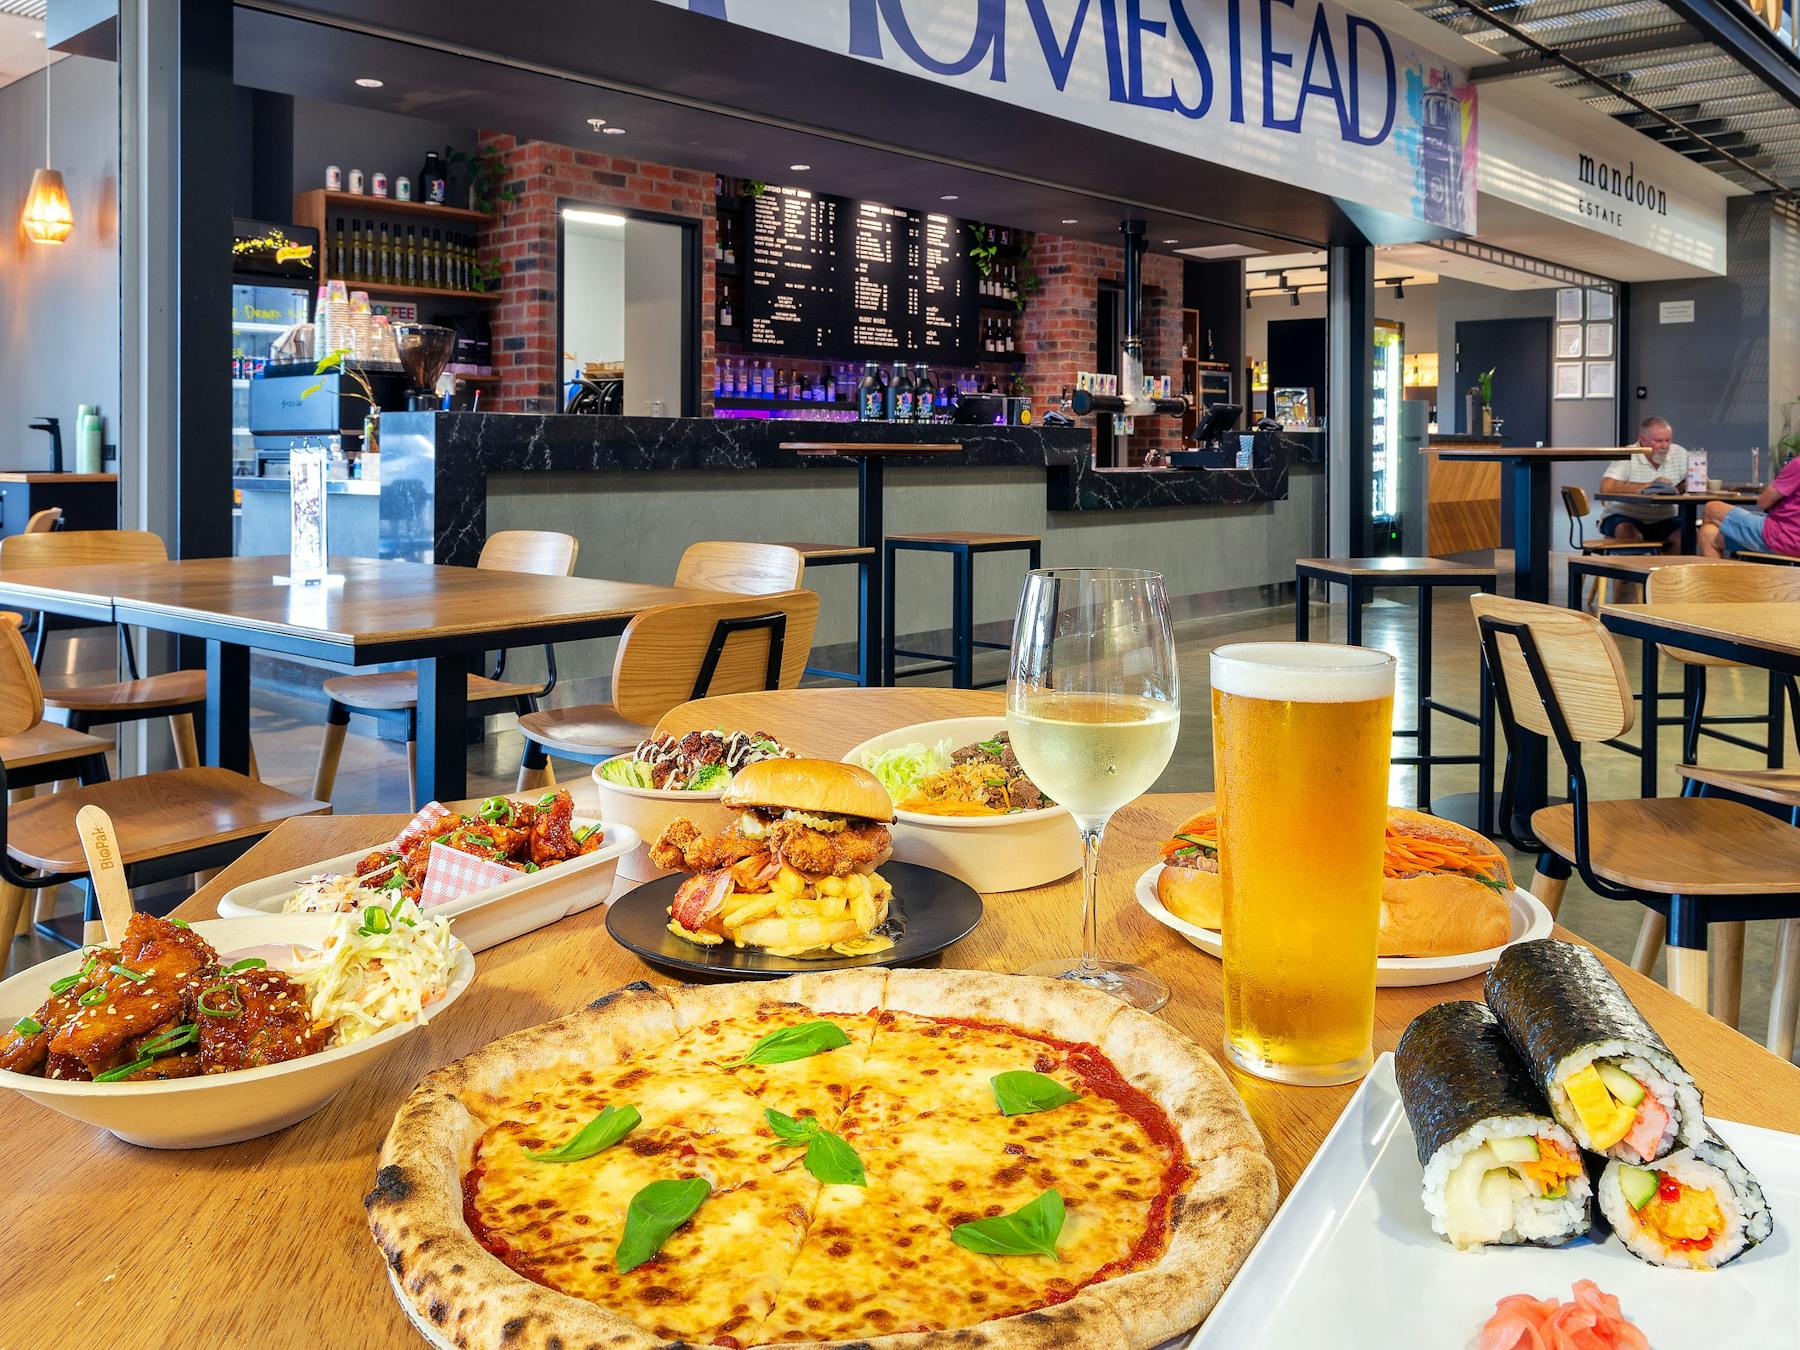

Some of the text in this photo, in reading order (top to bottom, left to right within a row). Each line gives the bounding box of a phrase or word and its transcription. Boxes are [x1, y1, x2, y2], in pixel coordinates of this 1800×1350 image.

[1579, 152, 1667, 216] mandoon
[1579, 200, 1622, 227] ESTATE
[370, 304, 415, 319] OFFEE
[92, 826, 114, 871] BioPak
